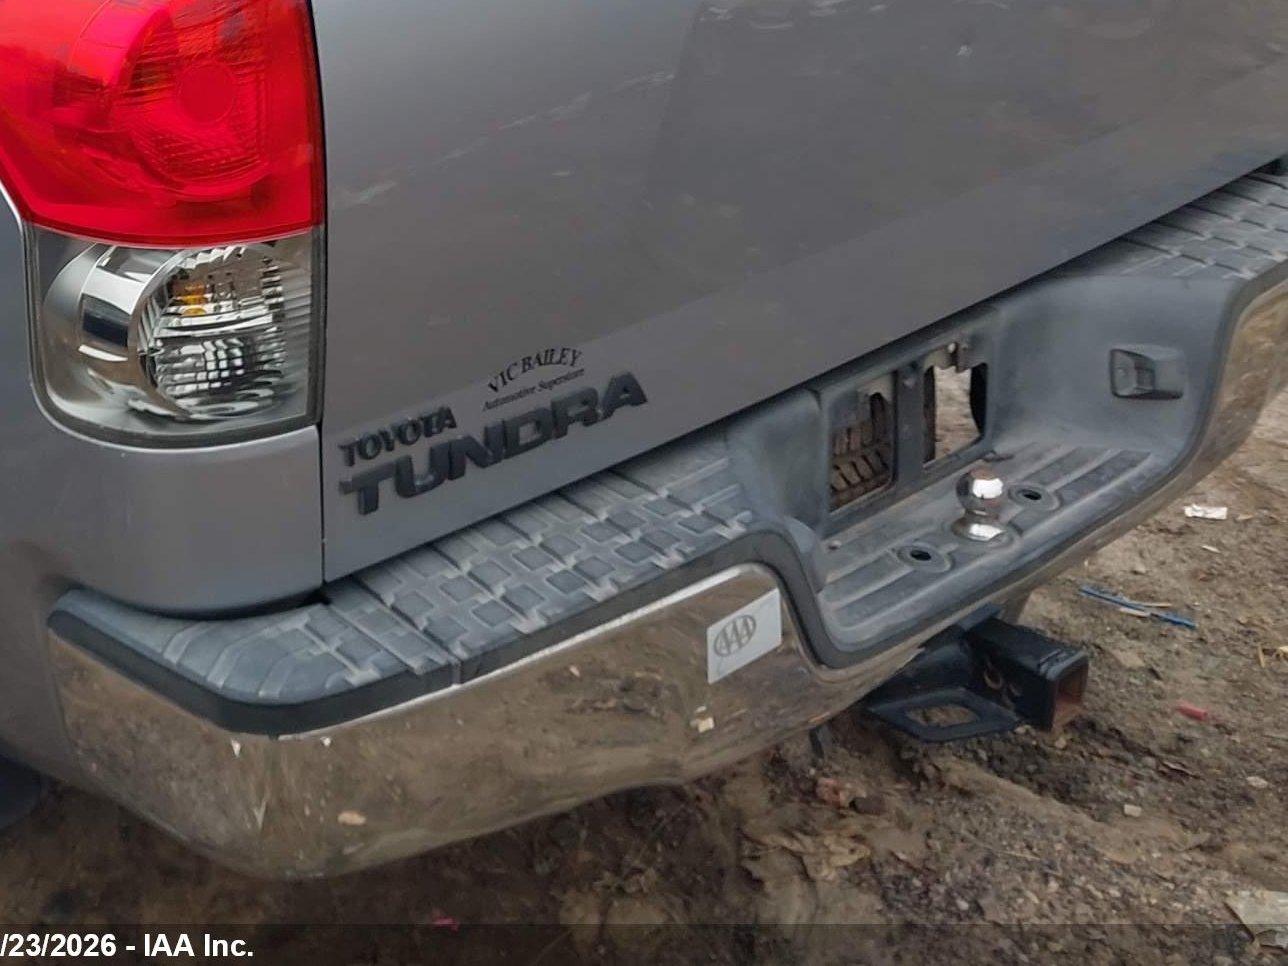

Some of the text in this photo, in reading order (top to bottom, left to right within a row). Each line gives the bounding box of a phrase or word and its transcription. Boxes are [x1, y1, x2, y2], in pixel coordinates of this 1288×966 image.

[488, 347, 583, 393] VIC BAILEY
[338, 405, 457, 467] TOYOTA
[338, 371, 648, 516] TUNDRA
